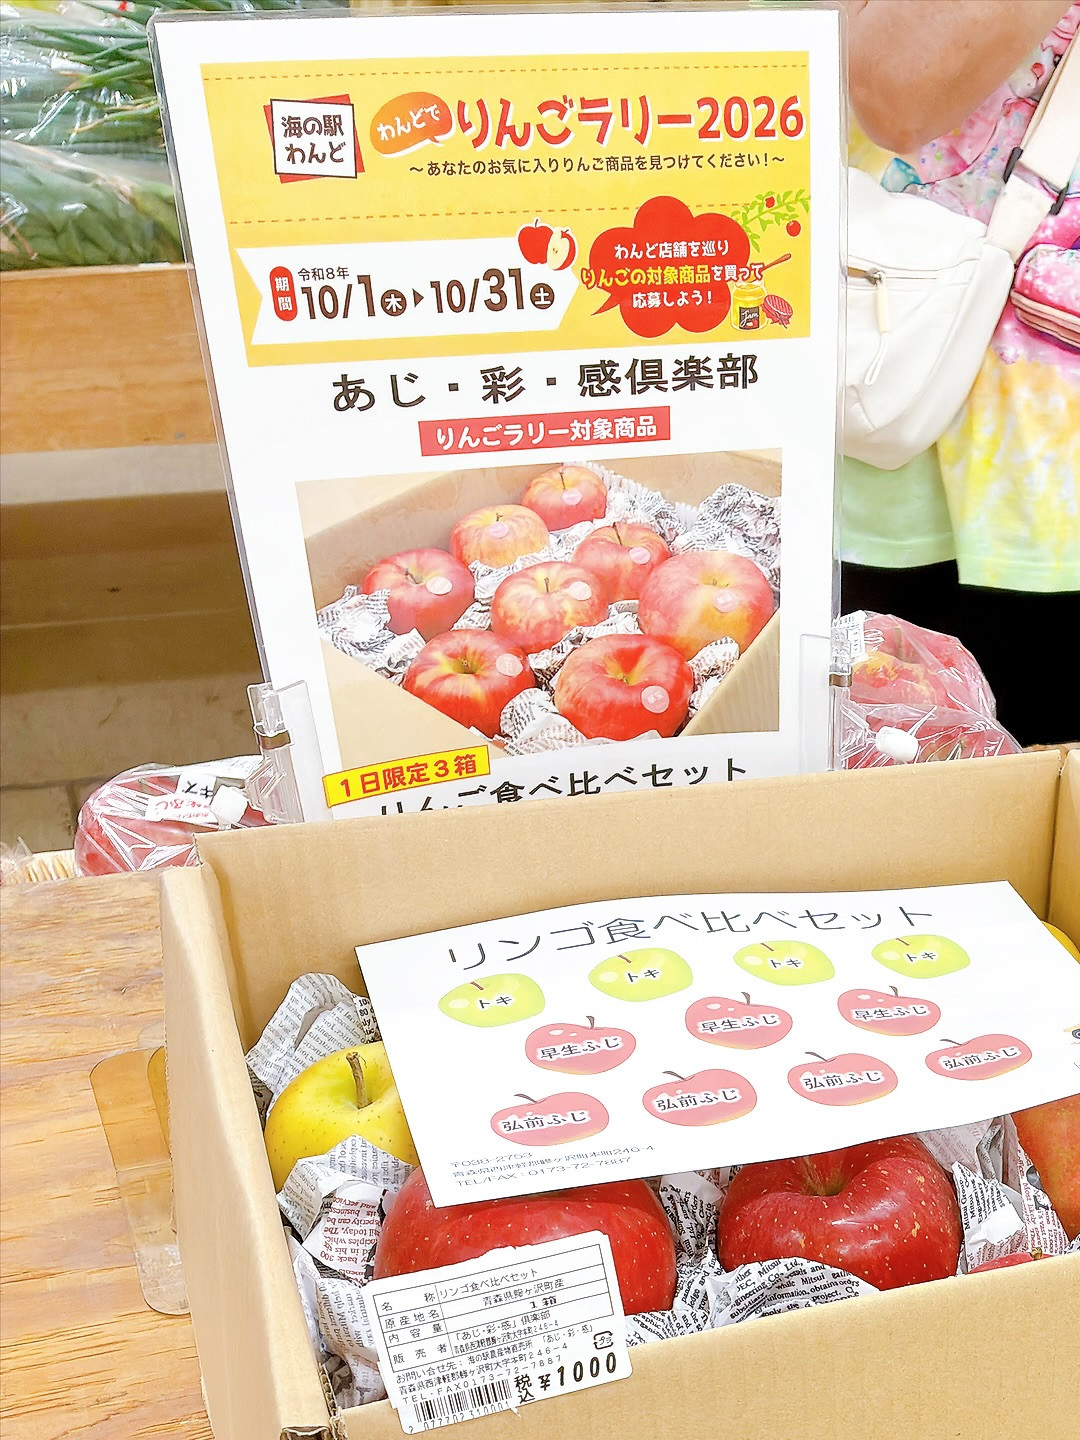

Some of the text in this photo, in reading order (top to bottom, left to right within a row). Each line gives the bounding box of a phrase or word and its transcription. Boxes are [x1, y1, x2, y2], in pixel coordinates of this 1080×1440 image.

[281, 114, 344, 138] 海の駅
[377, 94, 805, 150] わんどで りんごラリー2026
[285, 141, 346, 165] わんど
[614, 240, 730, 260] わんど店舗を巡り
[297, 266, 350, 281] 令和8年
[581, 263, 764, 288] りんごの対象商品を買って
[274, 276, 293, 312] 期間
[435, 415, 658, 450] りんごラリー対象商品
[448, 906, 933, 970] リンゴ食べ比べセット
[770, 958, 802, 970] トキ
[905, 951, 937, 963] トキ
[626, 968, 660, 982] トキ
[478, 994, 512, 1009] トキ
[854, 1004, 928, 1020] 早生ふじ
[700, 1014, 780, 1034] 早生ふじ
[540, 1037, 621, 1060] 早生ふじ
[942, 1047, 1019, 1070] 弘前ふじ
[803, 1070, 883, 1090] 弘前ふじ
[655, 1089, 739, 1111] 弘前ふじ
[501, 1111, 587, 1132] 弘前ふじ
[440, 1268, 538, 1298] リンゴ食べ比べセット
[385, 1309, 440, 1329] 原産地名
